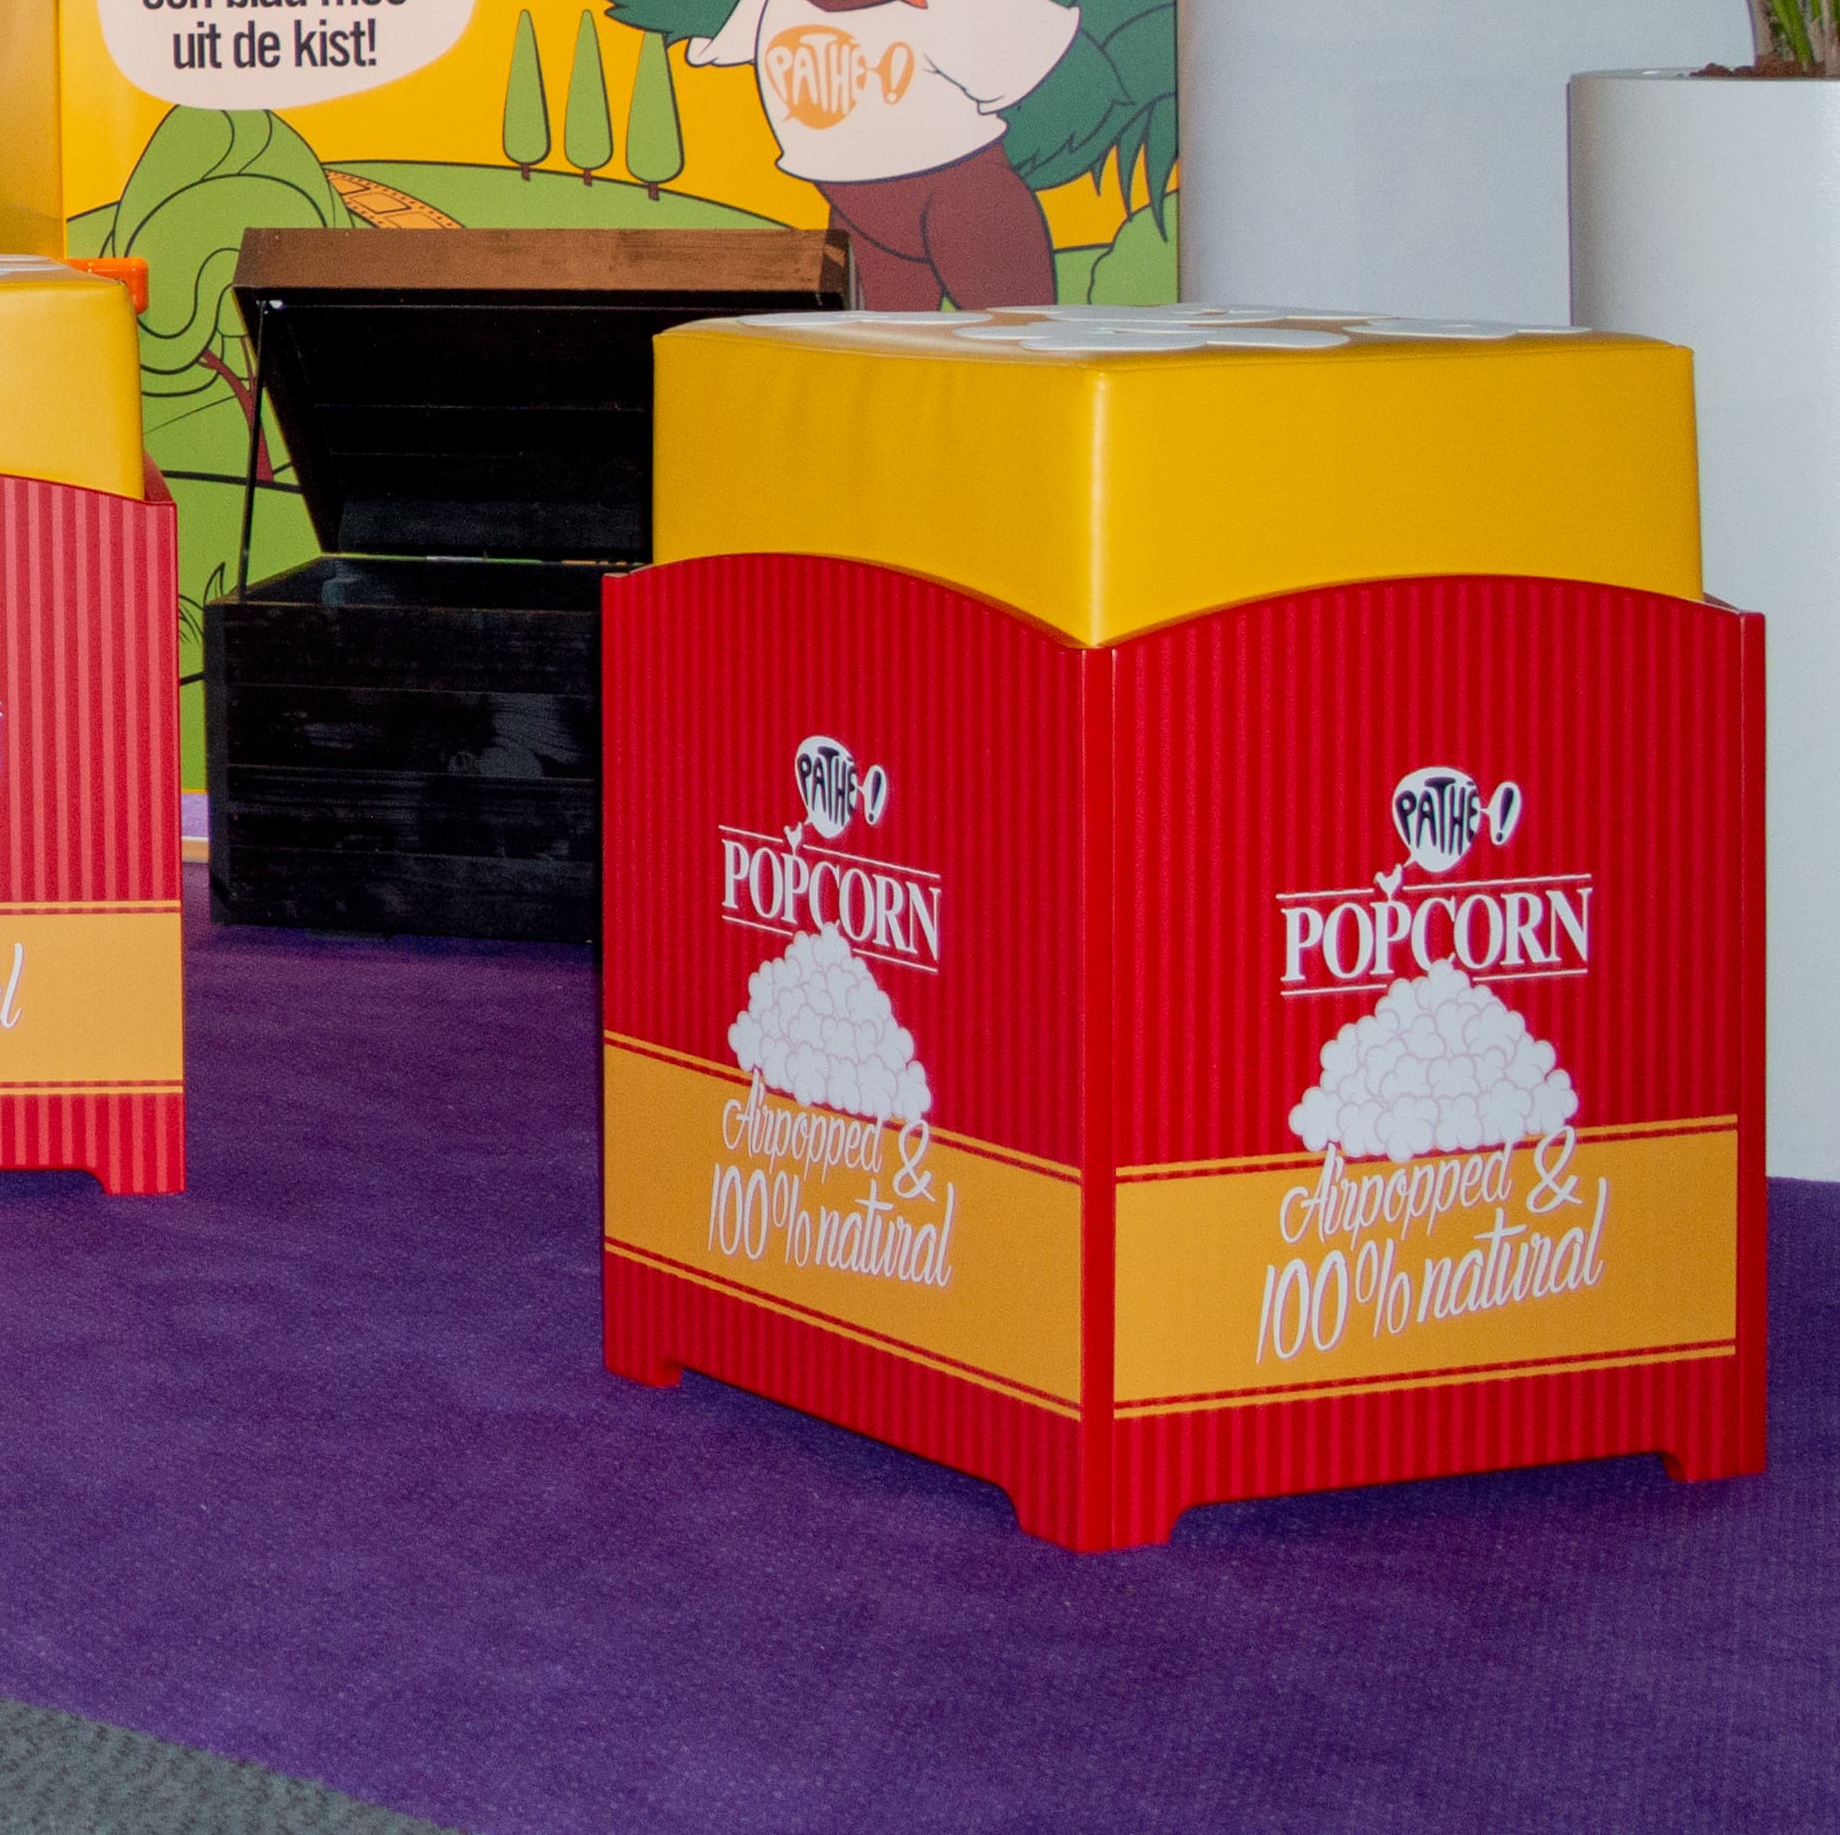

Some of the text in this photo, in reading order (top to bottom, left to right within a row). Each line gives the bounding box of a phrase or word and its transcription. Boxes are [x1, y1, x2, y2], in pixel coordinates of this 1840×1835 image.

[173, 18, 377, 70] uit de kist!
[721, 838, 942, 962] POPCORN
[1280, 886, 1594, 982] POPCORN
[722, 1066, 936, 1202] Airpopped &
[1278, 1125, 1584, 1251] Airpopped &
[707, 1162, 955, 1287] 100% natural
[1255, 1177, 1608, 1365] 100% natural
